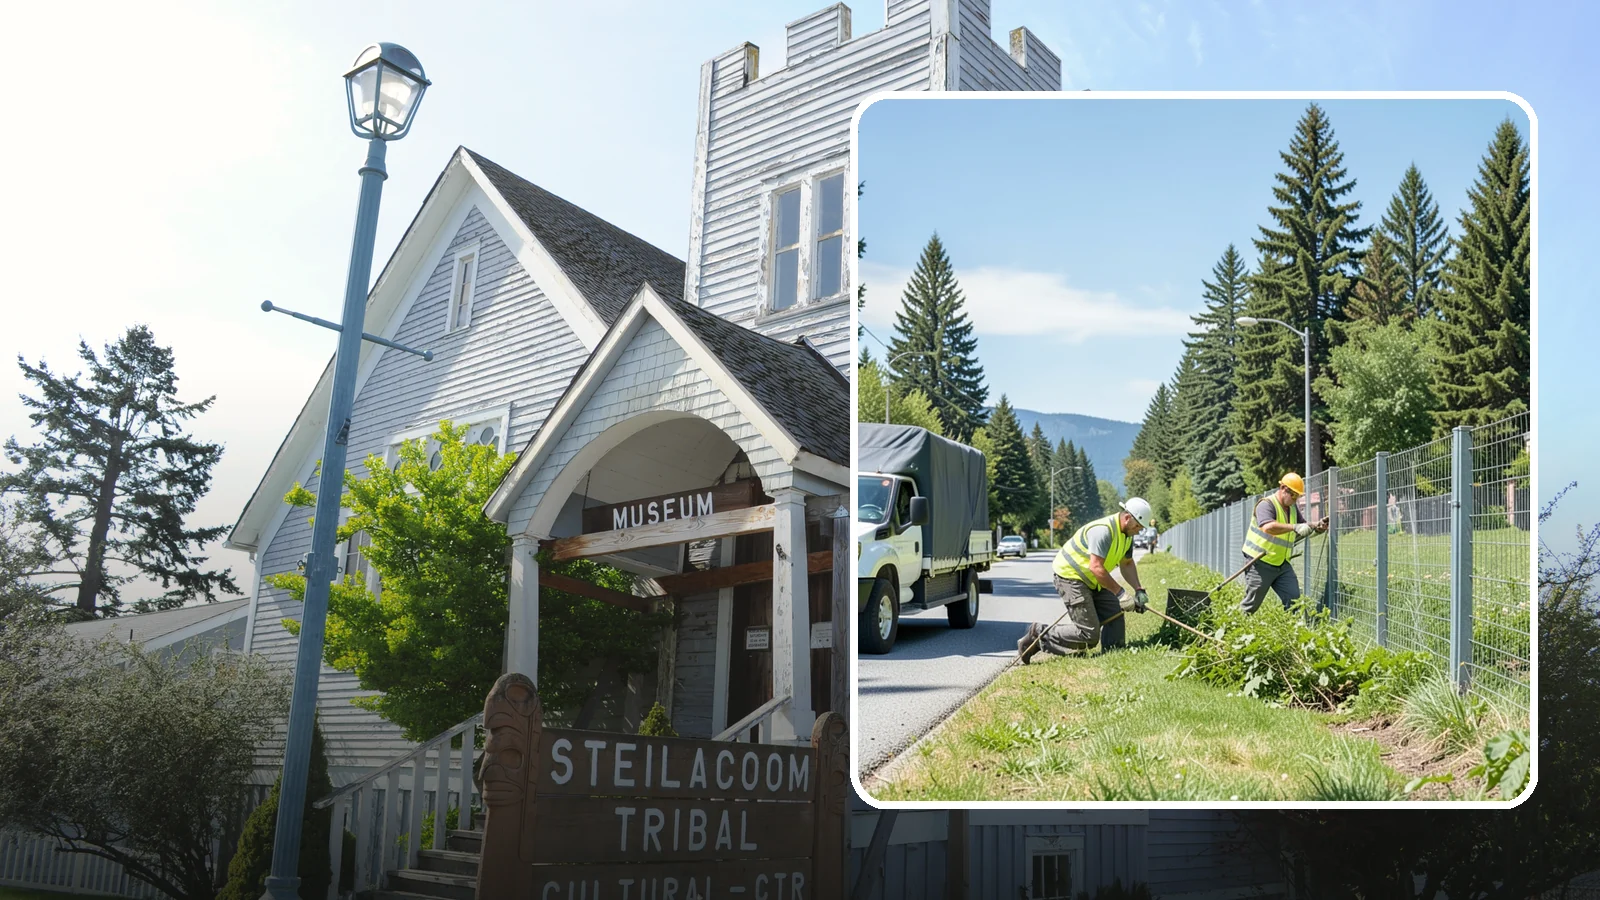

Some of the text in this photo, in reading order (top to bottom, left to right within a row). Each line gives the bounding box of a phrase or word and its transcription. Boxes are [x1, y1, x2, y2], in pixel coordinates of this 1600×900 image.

[613, 491, 714, 530] MUSEUM
[551, 738, 810, 792] STEILACOOM
[615, 807, 757, 852] TRIBAL
